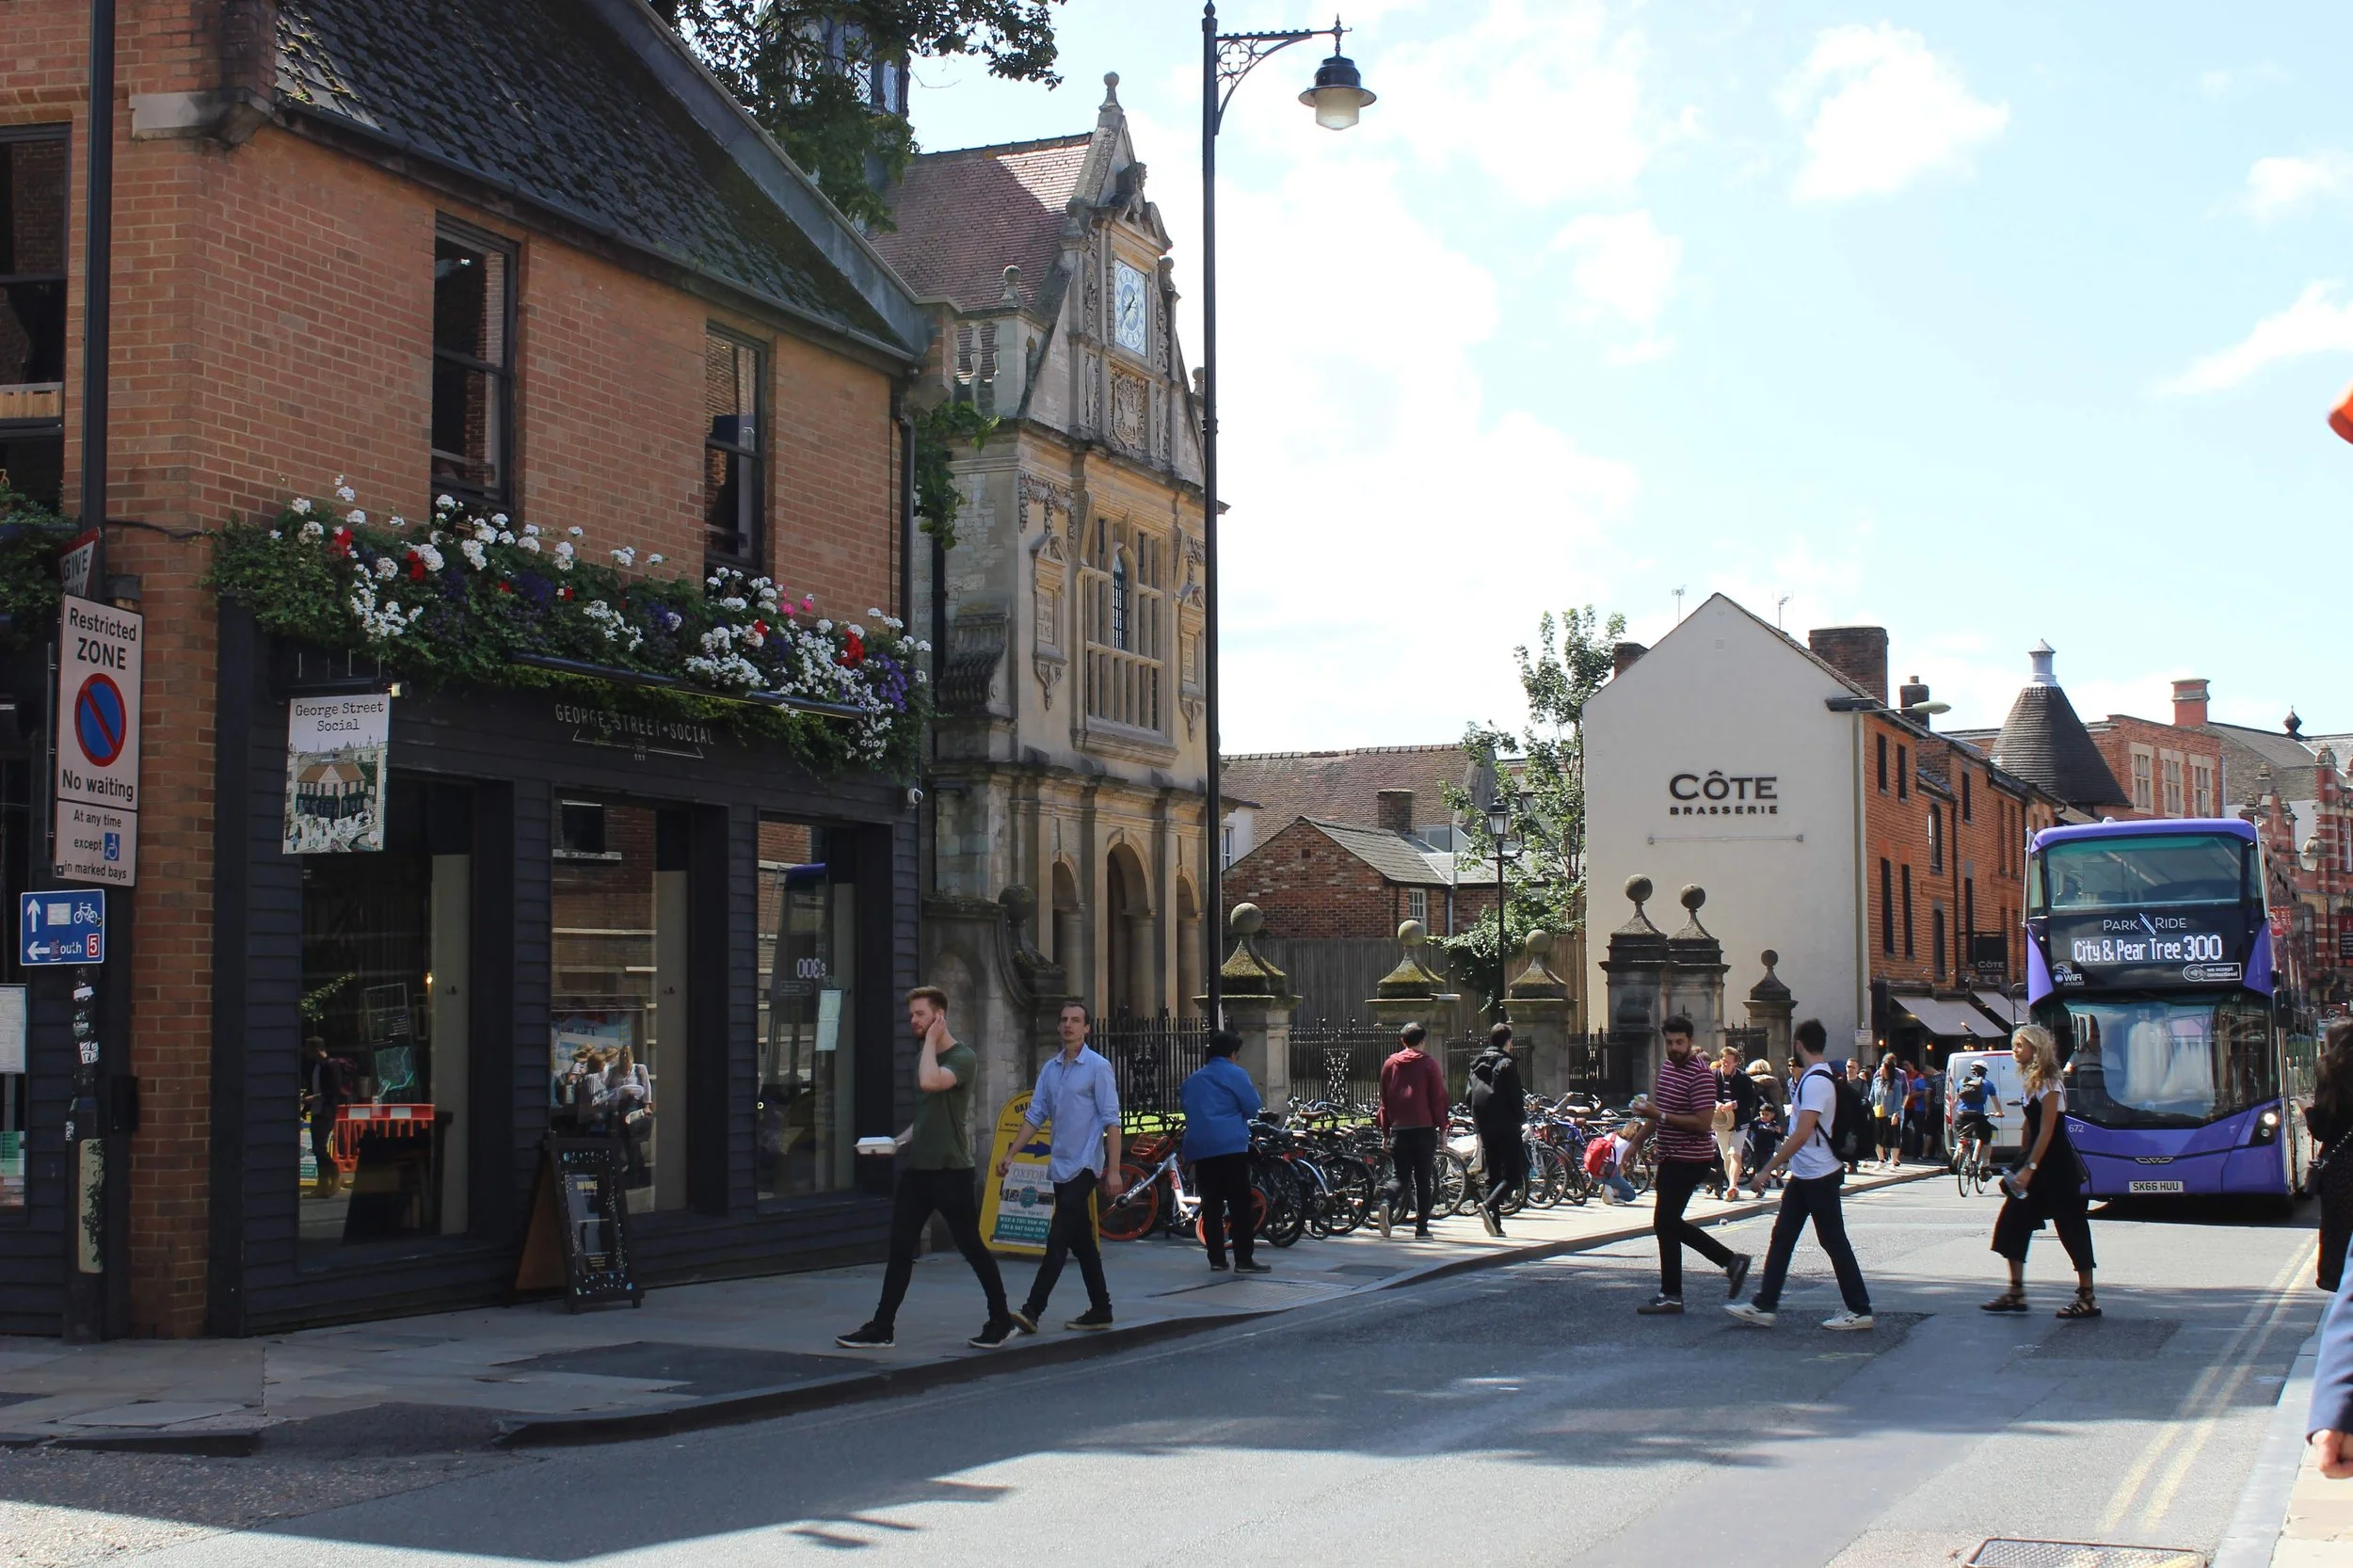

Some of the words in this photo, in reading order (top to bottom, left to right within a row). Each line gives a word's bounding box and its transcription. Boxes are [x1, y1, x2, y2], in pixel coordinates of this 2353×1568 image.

[63, 549, 88, 582] GIVE
[70, 607, 136, 642] Restricted
[77, 636, 127, 670] ZONE
[296, 704, 339, 718] George
[342, 701, 384, 715] Street
[317, 718, 360, 732] Social
[555, 703, 605, 728] GEORGE
[614, 713, 661, 737] STREET
[669, 722, 714, 745] SOCIAL
[62, 769, 82, 791] No
[87, 776, 134, 802] waiting
[1670, 770, 1778, 801] CÔTE
[73, 809, 84, 823] At
[87, 813, 102, 827] any
[104, 813, 122, 827] time
[1670, 806, 1778, 815] BRASSERIE
[73, 838, 103, 852] except
[65, 859, 72, 872] in
[74, 862, 106, 876] marked
[108, 866, 127, 881] bays
[2103, 919, 2138, 931] PARK
[2154, 917, 2186, 929] RIDE
[89, 936, 98, 953] 5
[2073, 939, 2100, 963] City
[2103, 939, 2115, 962] &
[2117, 938, 2146, 962] Pear
[2149, 937, 2182, 960] Tree
[2183, 935, 2222, 962] 300
[1977, 960, 2004, 968] CÔTE
[2068, 1124, 2084, 1132] 672
[2133, 1182, 2157, 1191] SK66
[2160, 1182, 2179, 1191] HUU
